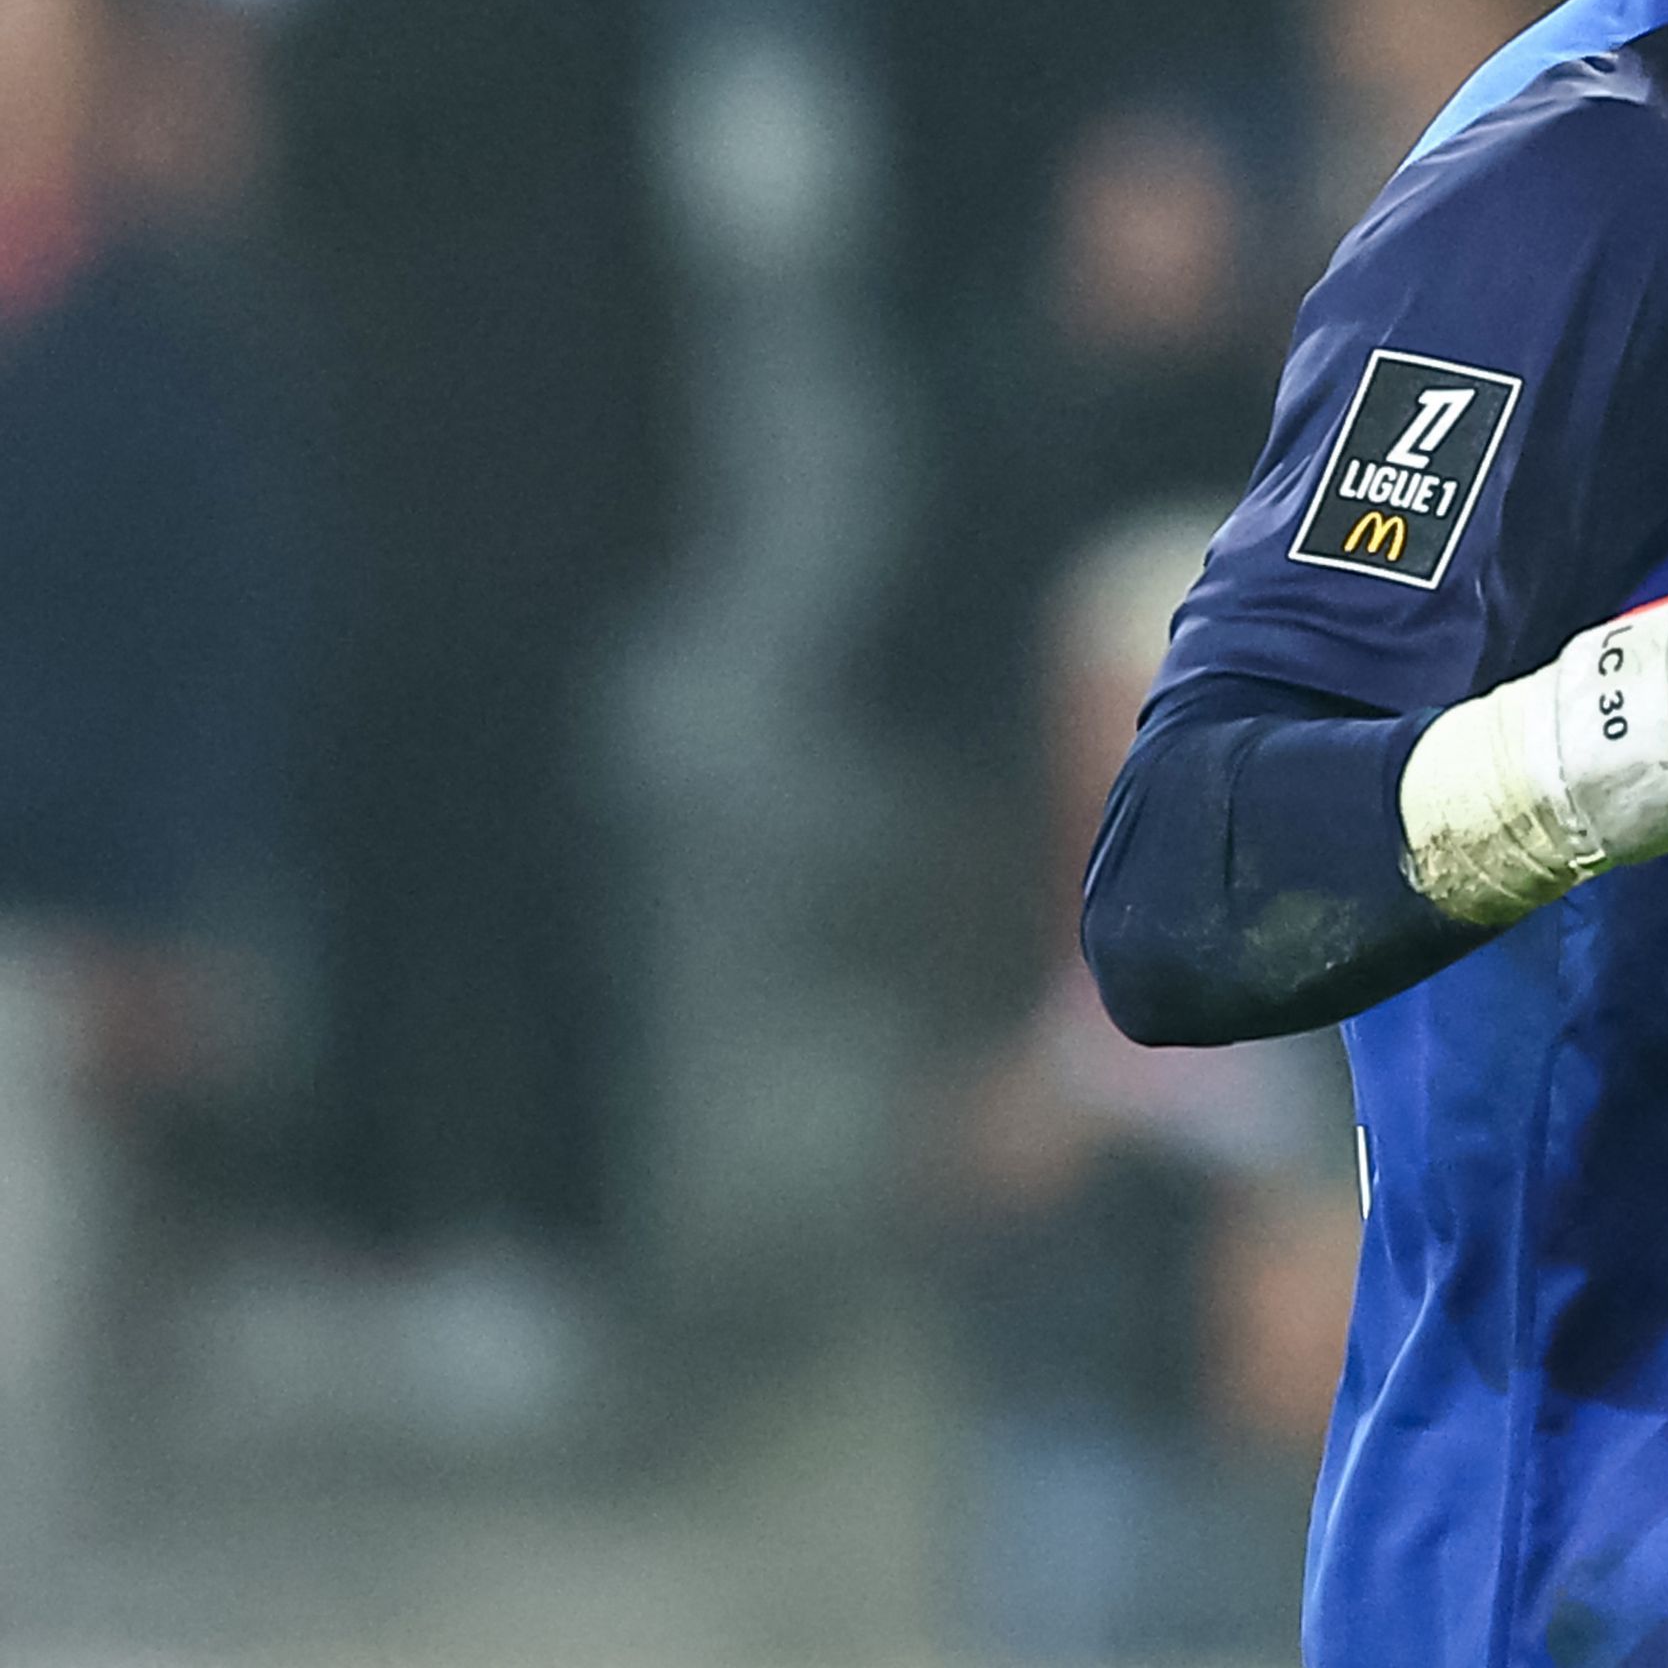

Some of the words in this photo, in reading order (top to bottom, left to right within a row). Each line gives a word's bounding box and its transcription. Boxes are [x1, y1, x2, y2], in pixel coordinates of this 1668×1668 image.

[1339, 459, 1441, 514] LIGUE
[1434, 480, 1458, 518] 1
[1599, 689, 1629, 741] 30
